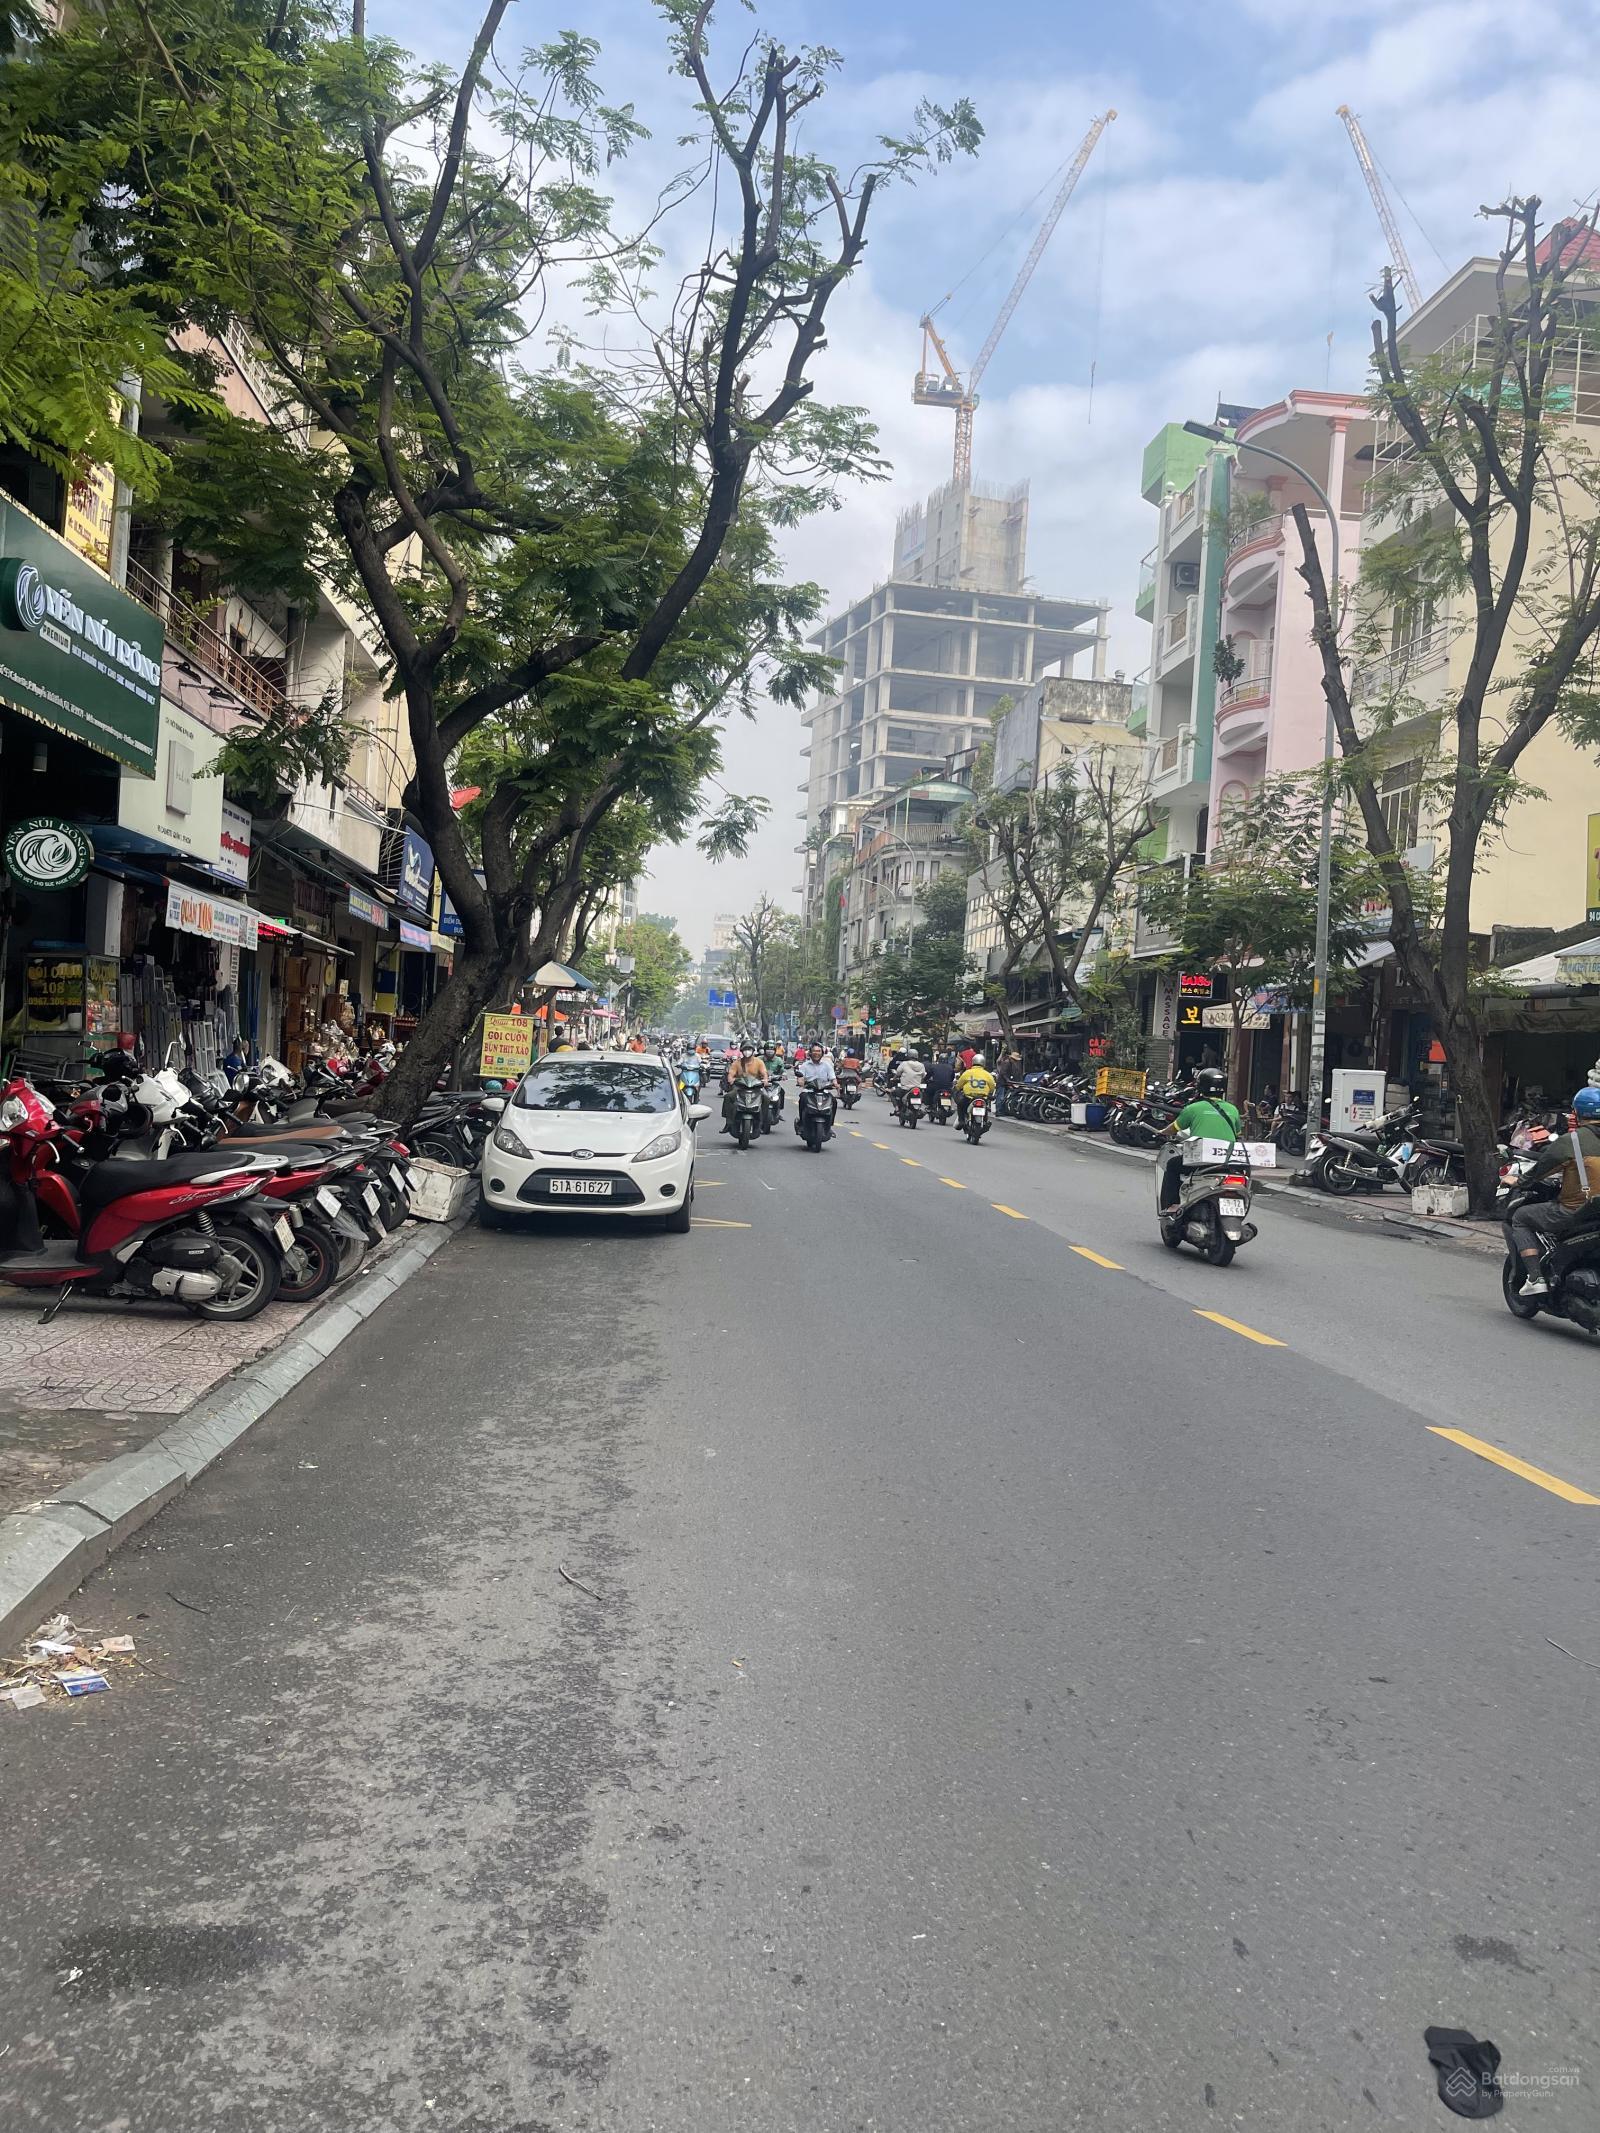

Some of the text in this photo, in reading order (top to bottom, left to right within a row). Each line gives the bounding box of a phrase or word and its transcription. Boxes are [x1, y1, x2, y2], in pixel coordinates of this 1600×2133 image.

[42, 624, 70, 650] PREMIUM
[45, 584, 160, 687] YẾN NÚI RỒNG
[6, 817, 87, 856] YẾN NÚI RỒNG
[197, 901, 213, 932] 108
[42, 981, 65, 994] 108
[511, 1018, 528, 1028] 108
[1162, 987, 1173, 1038] MASSAGE
[1180, 1005, 1201, 1024] 보
[970, 1075, 987, 1088] be
